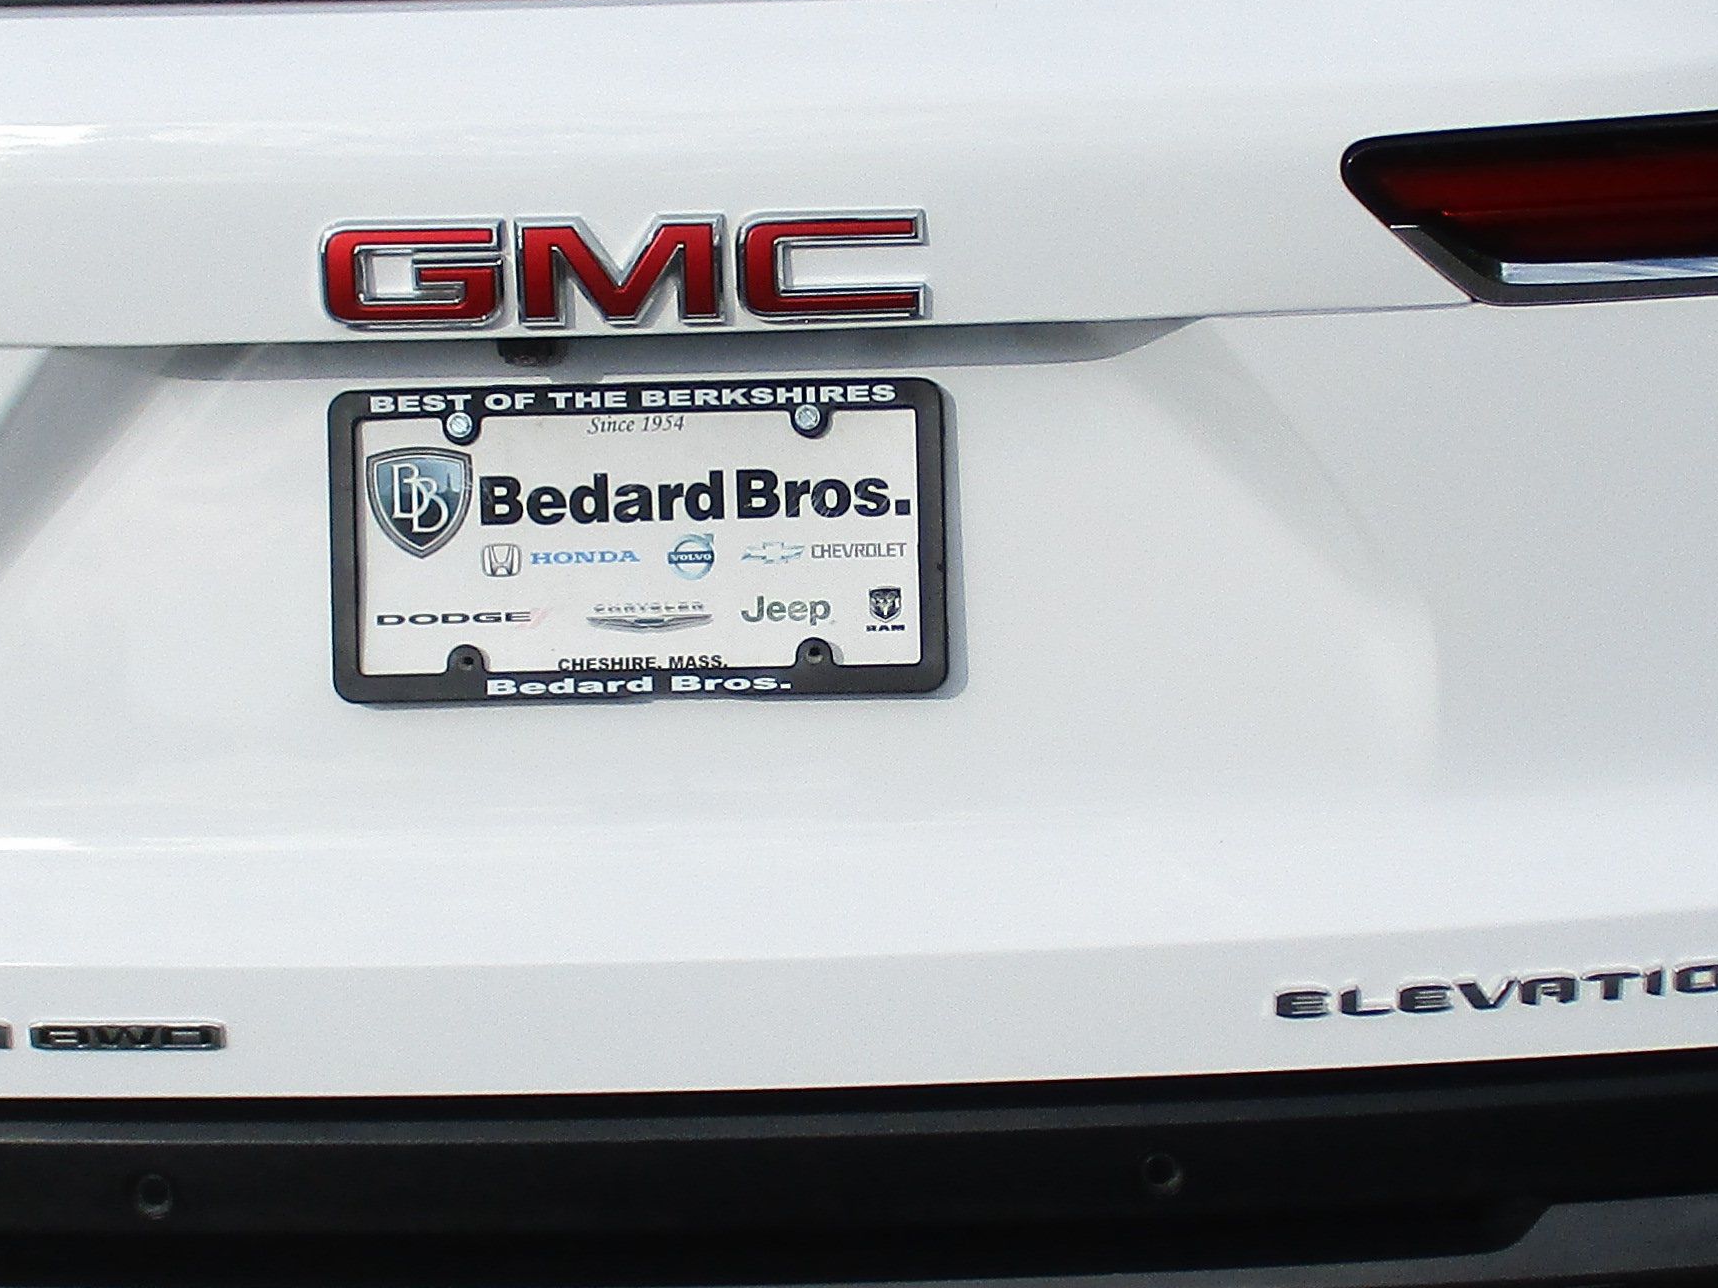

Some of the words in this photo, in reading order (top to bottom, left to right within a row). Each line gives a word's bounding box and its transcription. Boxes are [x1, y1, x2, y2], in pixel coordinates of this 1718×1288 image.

[319, 209, 928, 328] GMC
[370, 394, 472, 412] BEST
[484, 393, 535, 410] OF
[548, 391, 628, 408] THE
[641, 384, 896, 407] BERKSHIRES
[587, 416, 635, 434] Since
[642, 415, 684, 432] 1954
[479, 470, 725, 526] Bedard
[736, 469, 911, 519] Bros.
[530, 549, 640, 565] HONDA
[670, 554, 712, 562] VOLVO
[811, 542, 907, 559] CHEVROLET
[377, 611, 532, 626] DODGE
[740, 595, 831, 626] Jeep
[669, 654, 728, 669] MASS.
[487, 676, 653, 695] Bedard
[671, 675, 791, 692] Bros.
